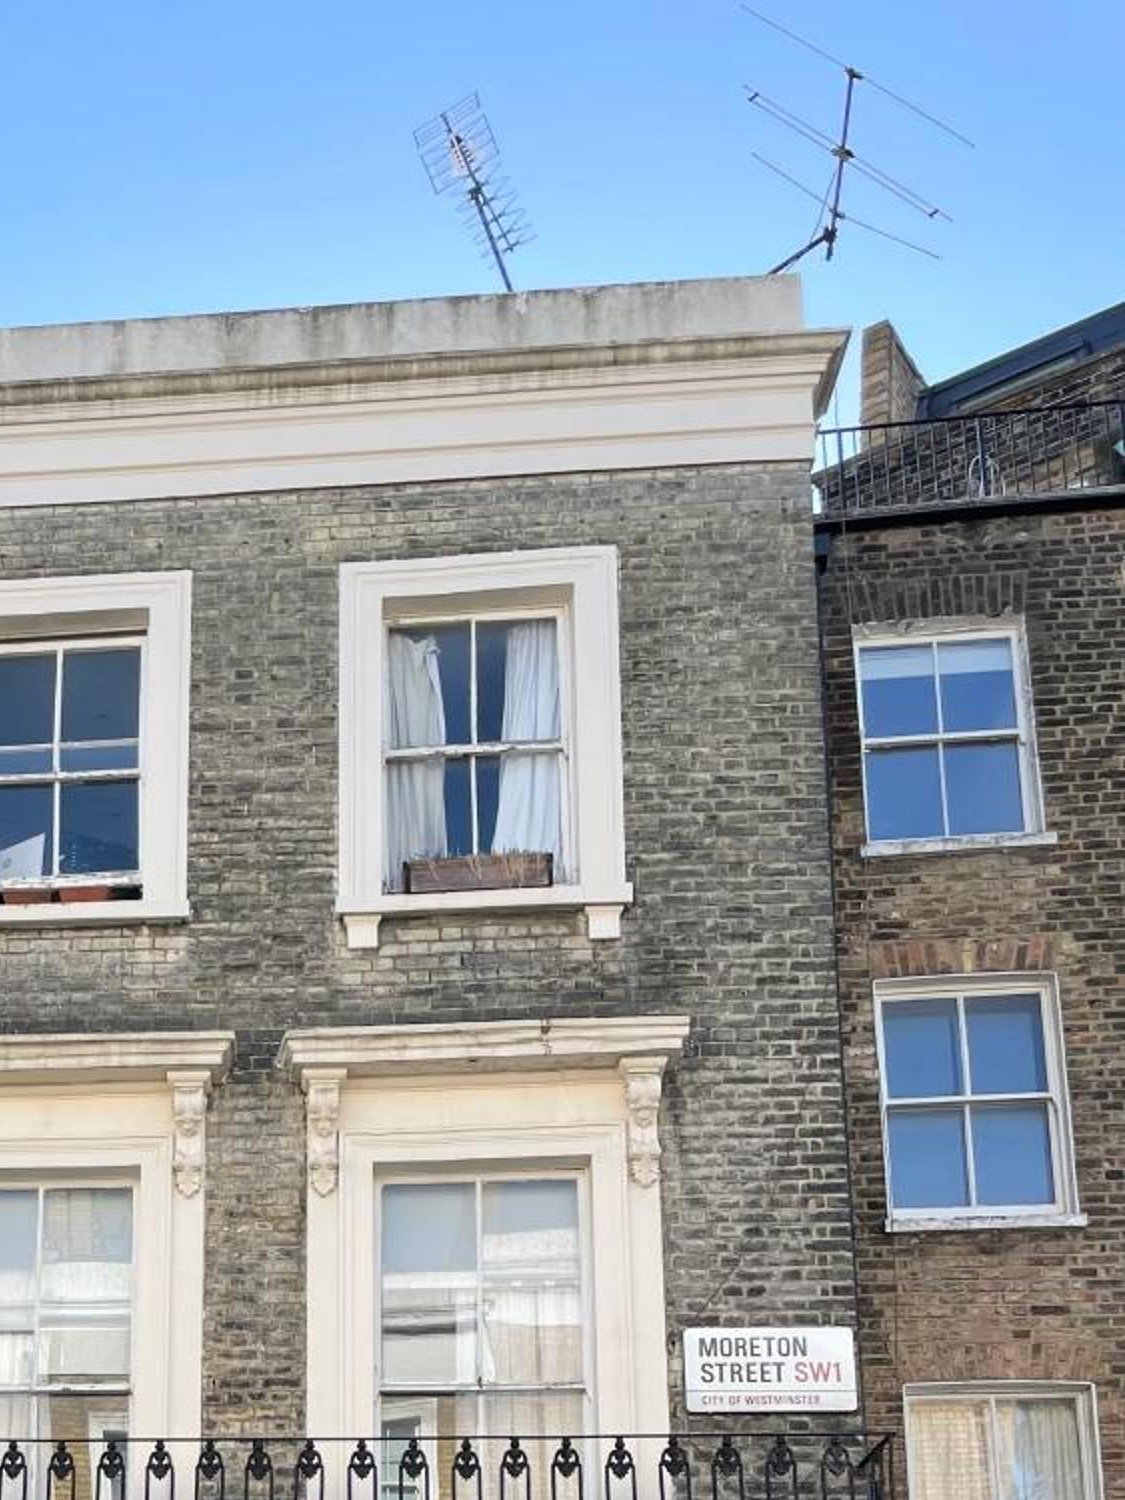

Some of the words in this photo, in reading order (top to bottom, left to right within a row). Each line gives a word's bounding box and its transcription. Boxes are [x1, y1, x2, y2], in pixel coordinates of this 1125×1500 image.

[698, 1336, 808, 1357] MORETON
[700, 1362, 786, 1383] STREET
[794, 1361, 843, 1383] SW1
[701, 1395, 724, 1406] CITY
[728, 1395, 742, 1406] OF
[744, 1395, 821, 1406] WESTMINSTER
